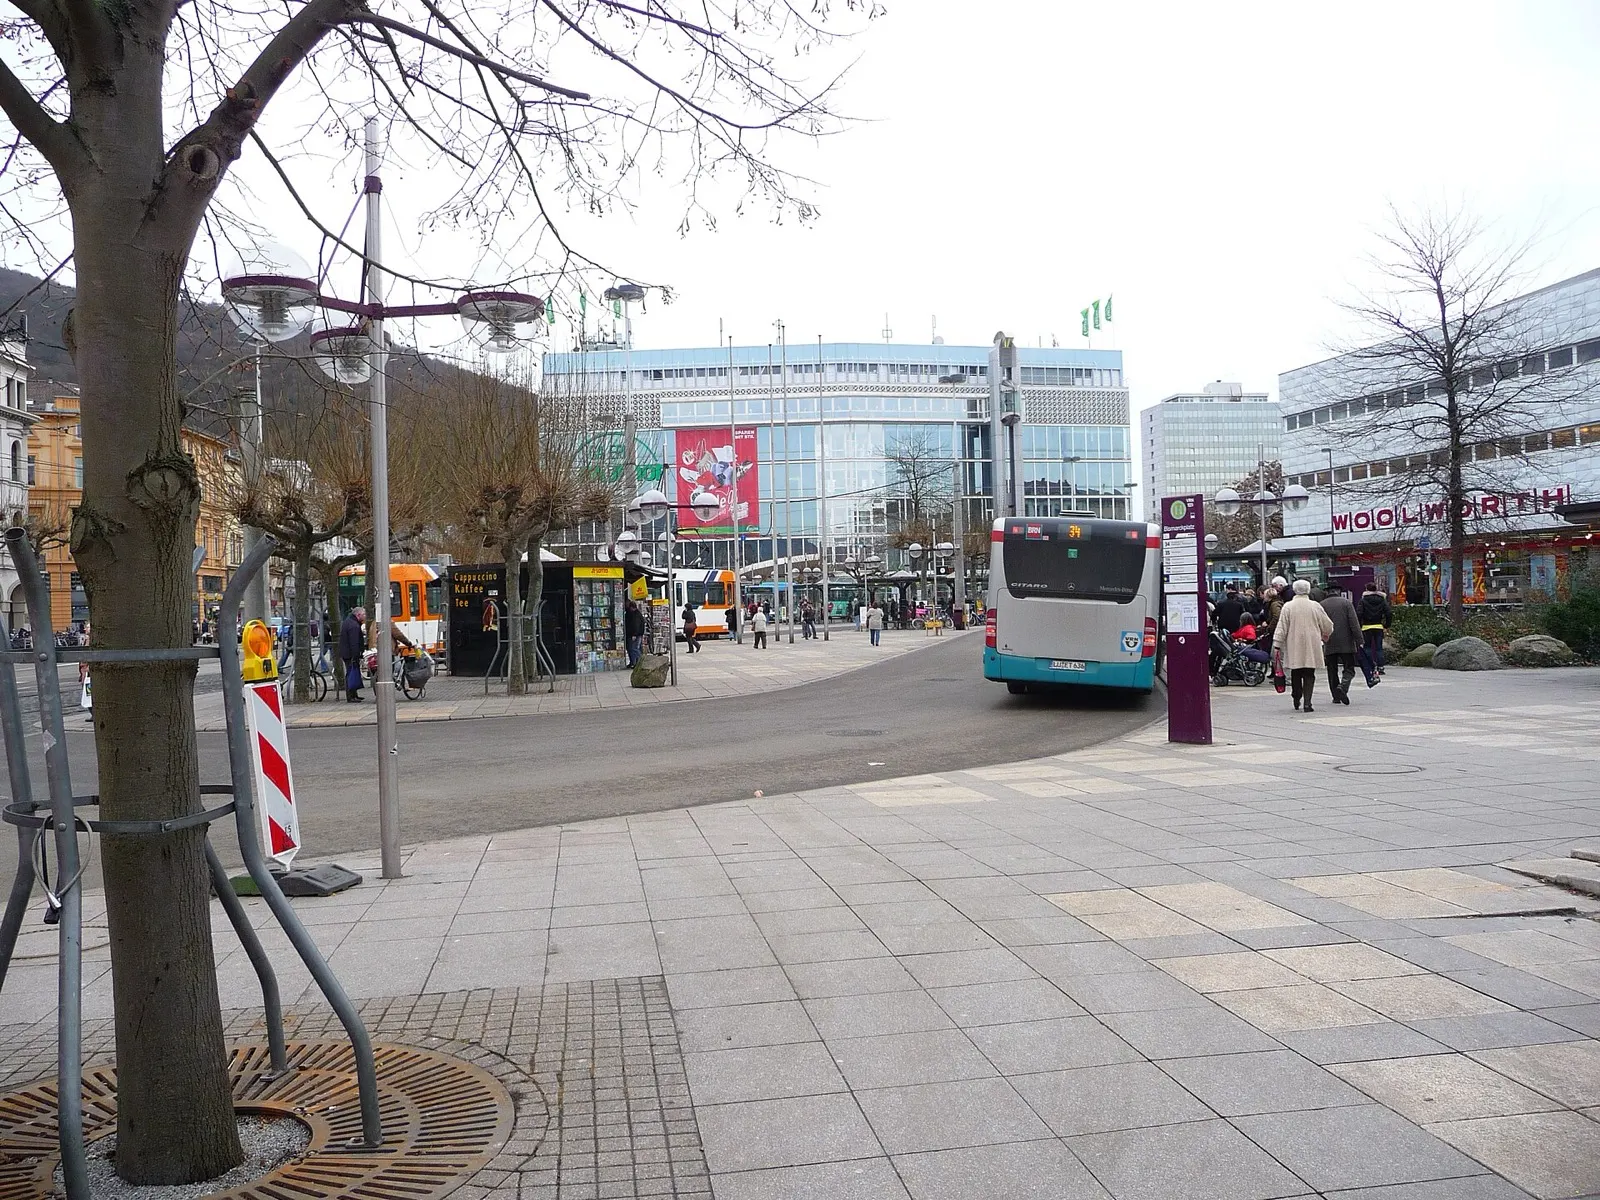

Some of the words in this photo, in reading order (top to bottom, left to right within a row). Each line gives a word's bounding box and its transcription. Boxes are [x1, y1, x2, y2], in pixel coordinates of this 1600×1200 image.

[1069, 523, 1081, 538] 34
[454, 572, 498, 583] Cappuccino
[454, 584, 484, 594] Kaffee
[455, 598, 469, 608] Tee
